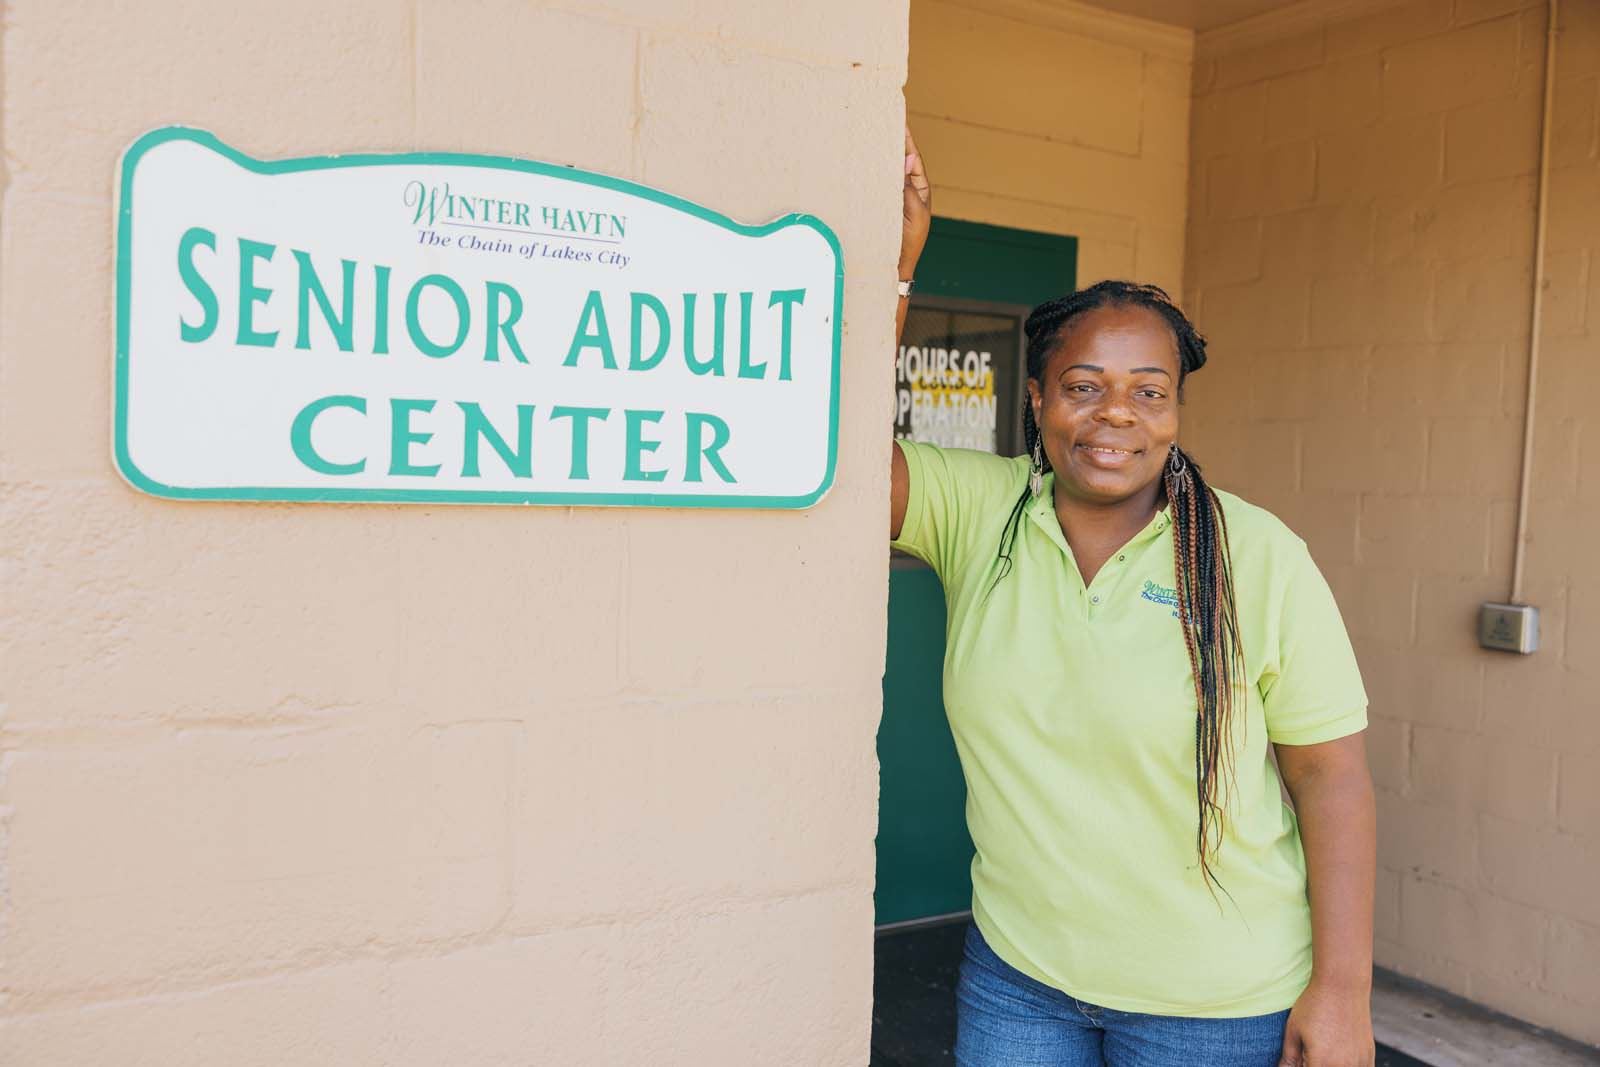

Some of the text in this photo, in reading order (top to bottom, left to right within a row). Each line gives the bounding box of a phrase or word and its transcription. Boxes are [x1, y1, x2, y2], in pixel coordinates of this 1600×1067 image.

[403, 180, 531, 227] WINTER
[417, 230, 631, 269] The Chain of Lakes City
[178, 226, 807, 382] SENIOR ADULT
[896, 345, 992, 388] HOURS OF
[290, 394, 738, 484] CENTER
